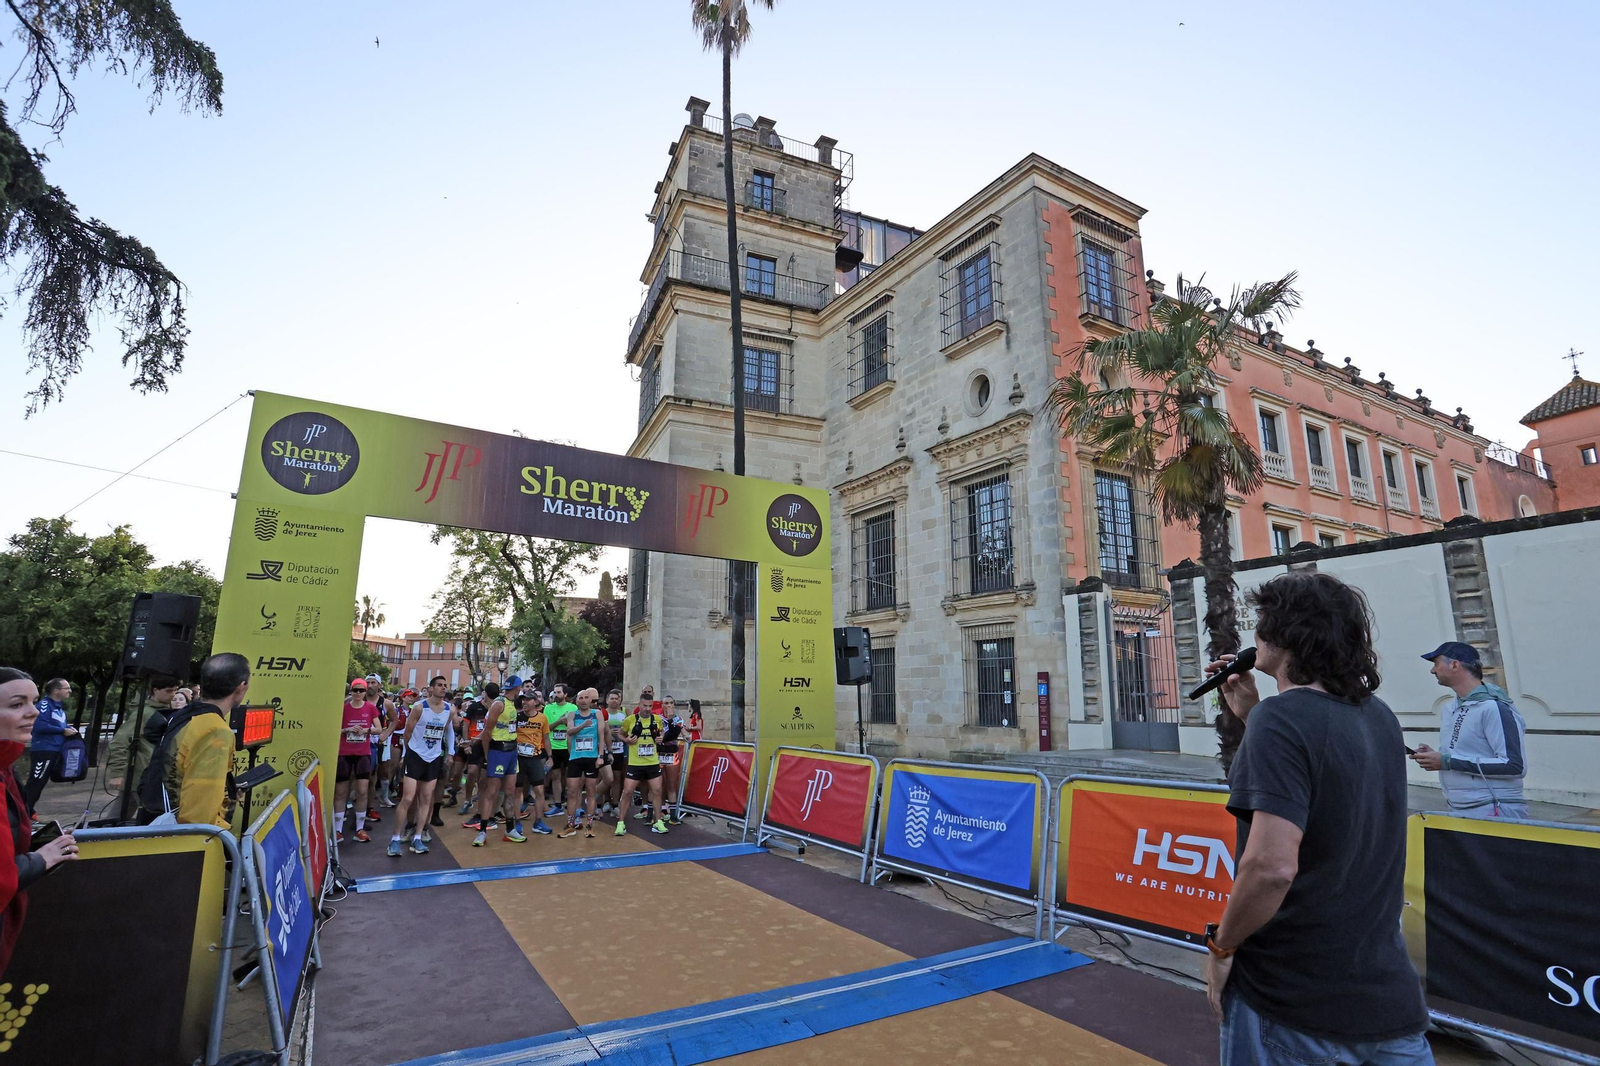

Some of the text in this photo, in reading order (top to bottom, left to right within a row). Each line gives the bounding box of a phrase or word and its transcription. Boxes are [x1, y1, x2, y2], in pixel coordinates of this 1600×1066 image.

[270, 440, 352, 471] Sherry
[283, 458, 337, 472] Maratón
[520, 465, 650, 521] Sherry
[542, 497, 629, 524] Maratón
[283, 520, 345, 533] Ayuntamiento
[295, 529, 317, 538] Jerez
[771, 516, 818, 538] Sherry
[779, 529, 811, 540] Maratón
[287, 562, 339, 575] Diputación
[286, 575, 329, 586] de Cádiz
[786, 576, 821, 585] Ayuntamiento
[792, 607, 822, 617] Diputación
[255, 656, 306, 671] HSN
[783, 677, 811, 688] HSN
[274, 719, 303, 730] PERS
[934, 808, 1008, 833] Ayuntamiento
[933, 824, 974, 843] de Jerez
[1132, 828, 1235, 882] HSN
[1115, 872, 1231, 903] WE ARE NUTRIT
